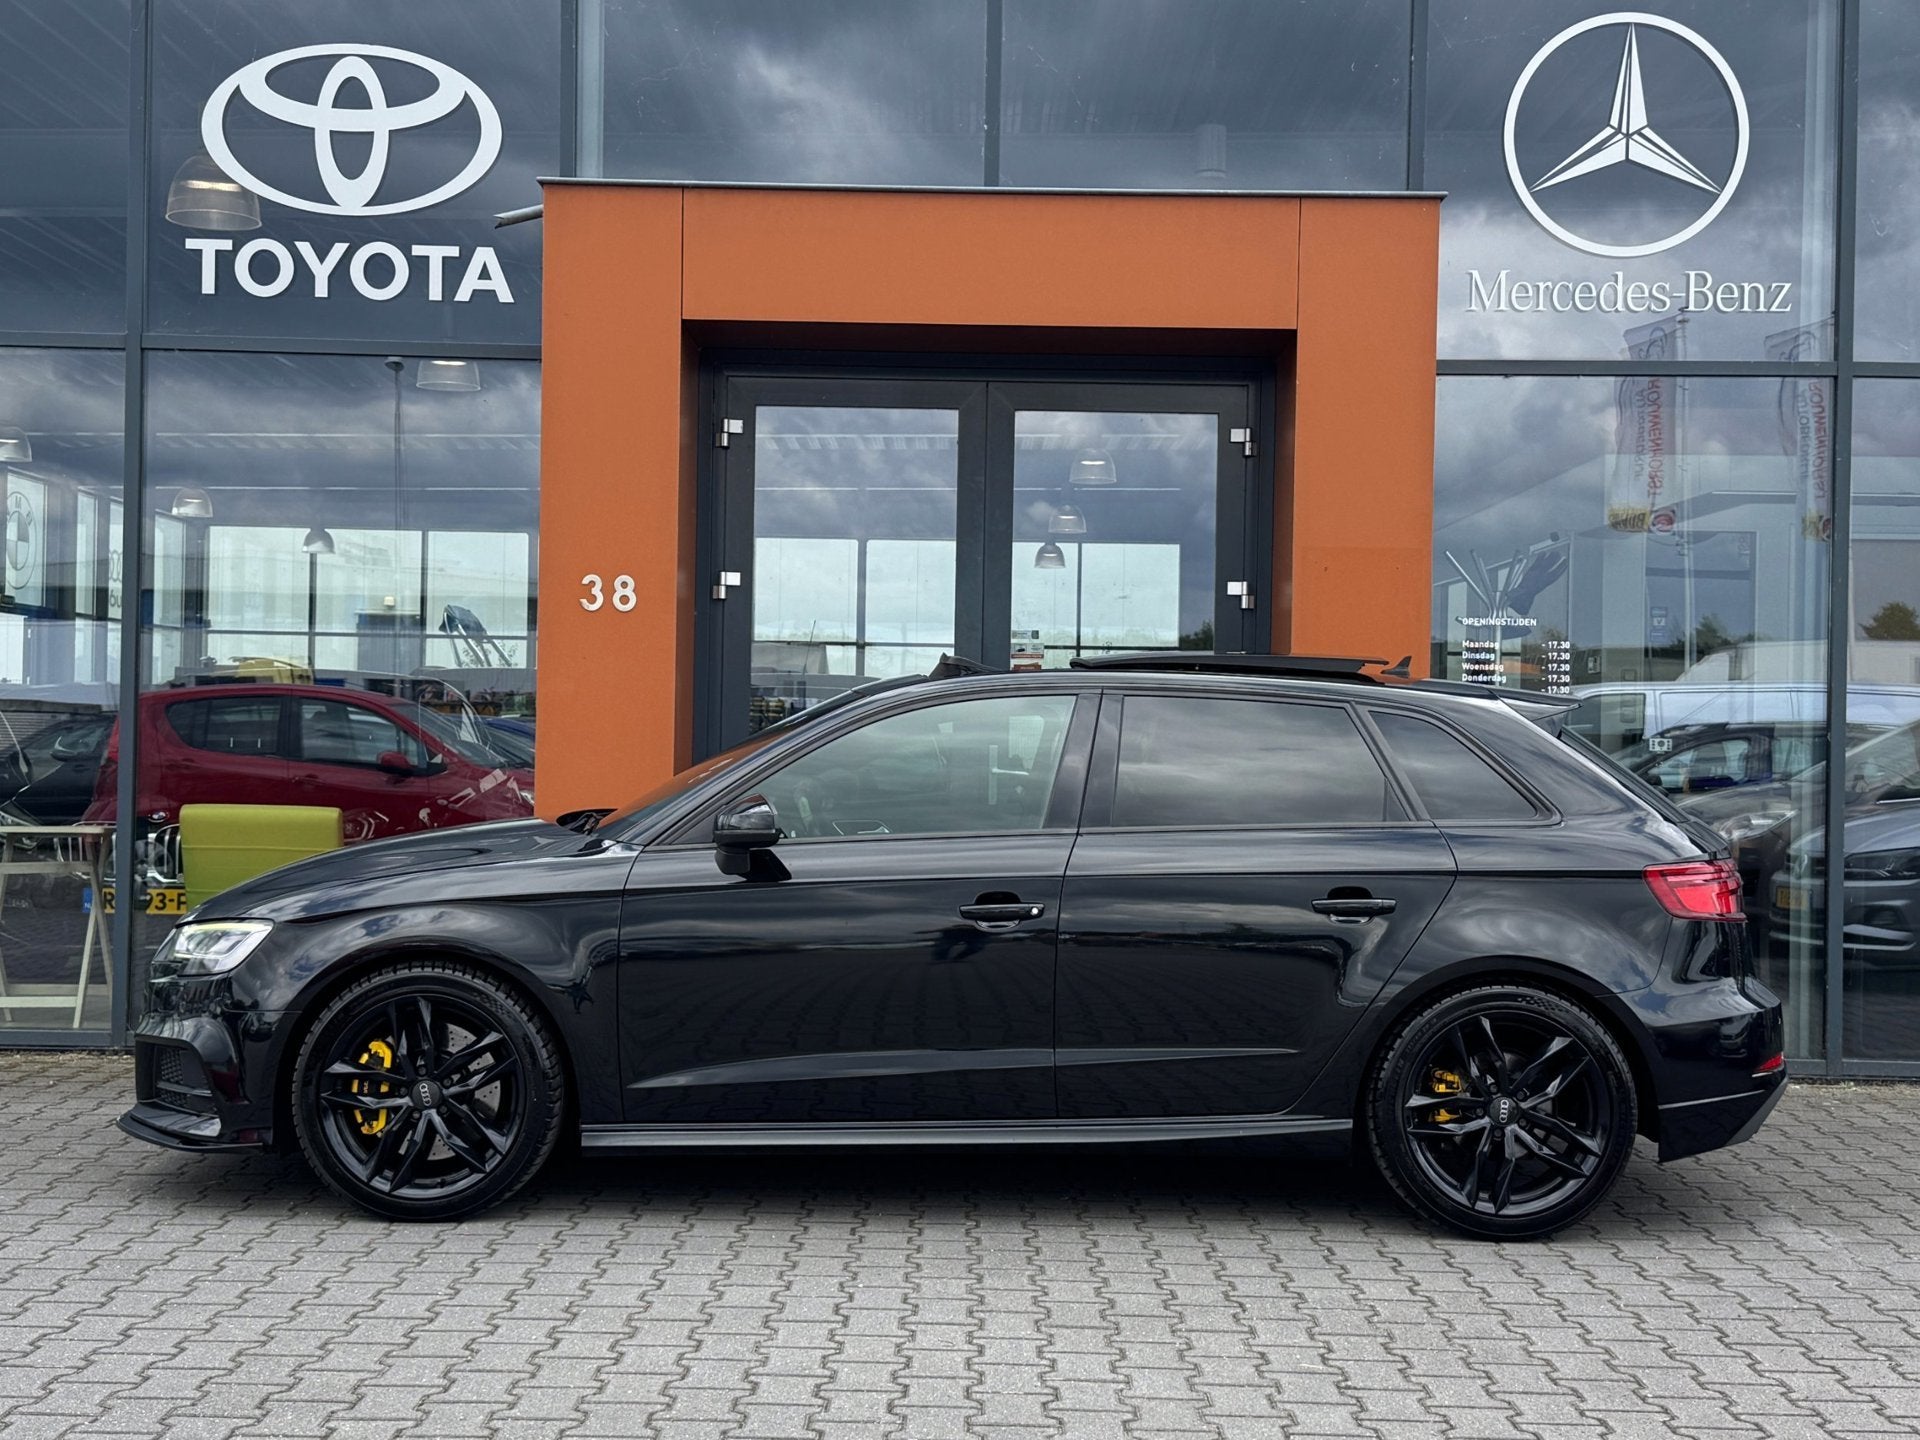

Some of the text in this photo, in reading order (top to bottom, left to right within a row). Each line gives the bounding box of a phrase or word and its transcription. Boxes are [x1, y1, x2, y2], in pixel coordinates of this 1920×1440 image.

[185, 238, 515, 303] TOYOTA
[1466, 269, 1793, 313] Mercedes-Benz
[580, 574, 637, 612] 38
[1462, 617, 1537, 627] OPENINGSTIJDEN
[1462, 640, 1499, 649] Maandag
[1462, 652, 1495, 661] Dinsdag
[1547, 652, 1571, 660] 17.30
[1462, 663, 1504, 672] Woensdag
[1462, 674, 1507, 683] Donderdag
[1547, 686, 1571, 694] 17.30
